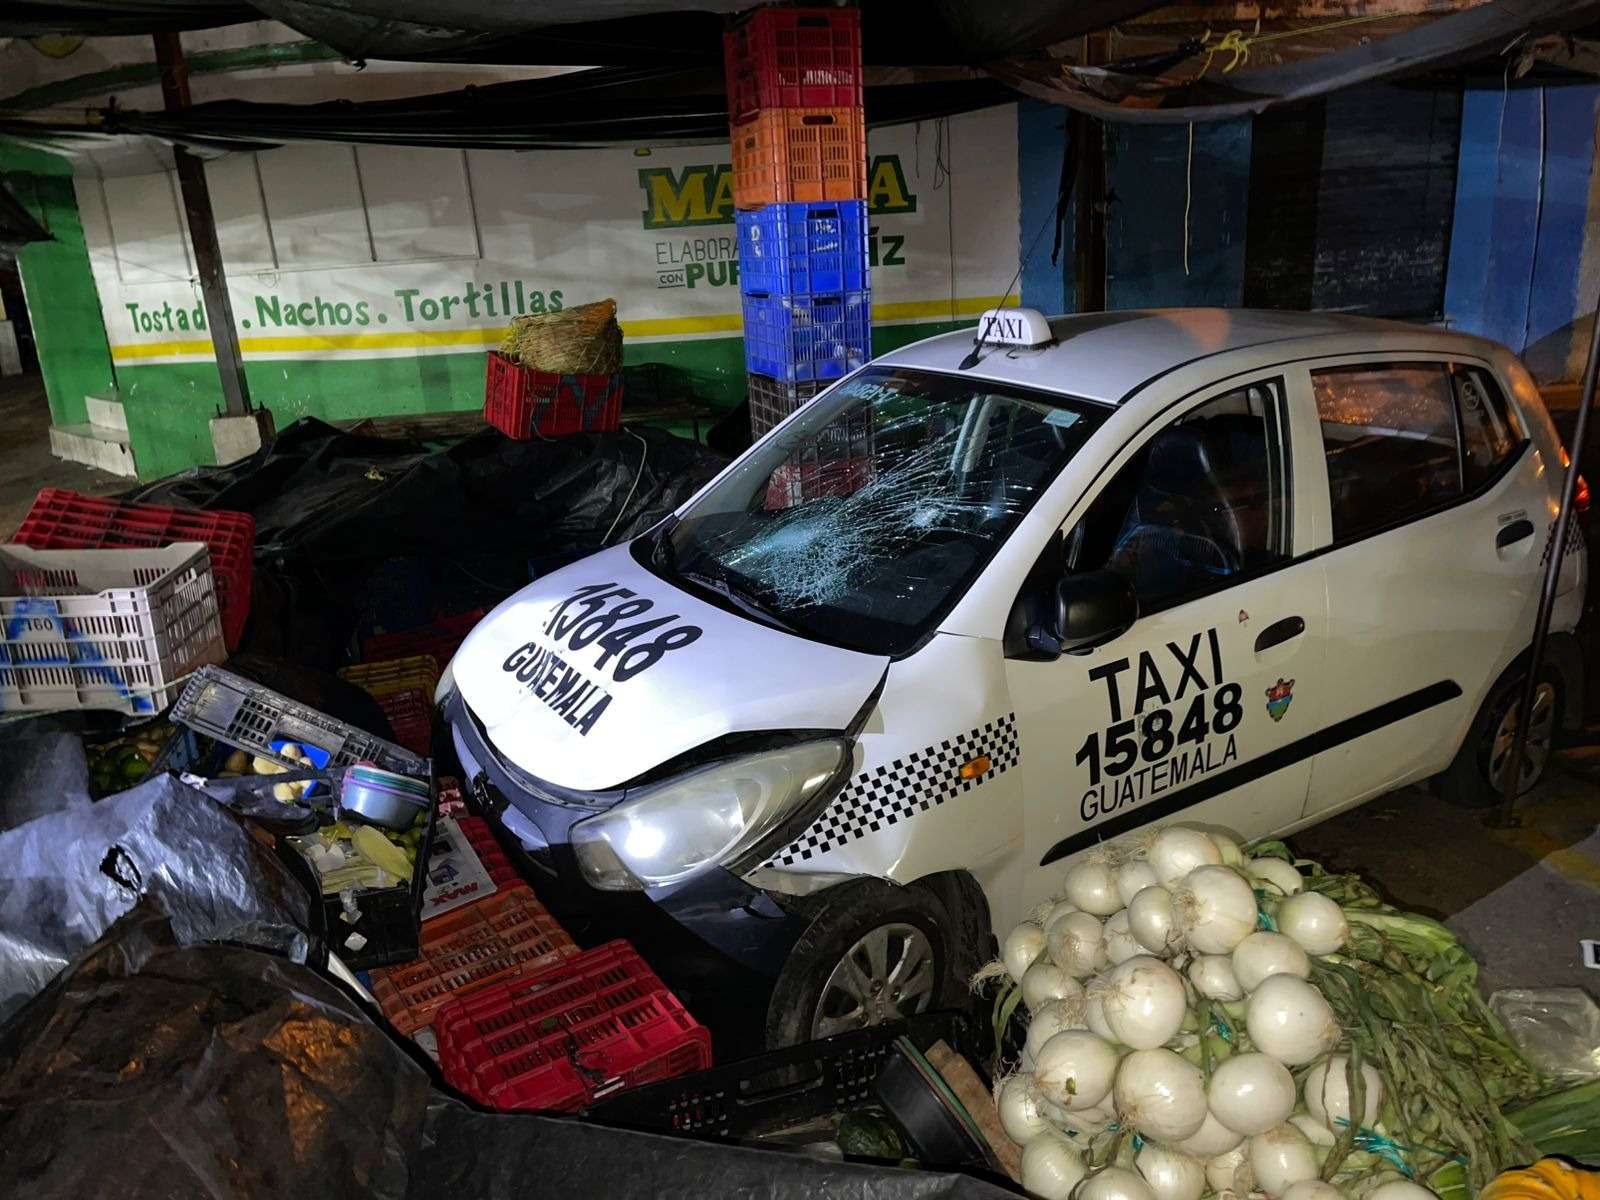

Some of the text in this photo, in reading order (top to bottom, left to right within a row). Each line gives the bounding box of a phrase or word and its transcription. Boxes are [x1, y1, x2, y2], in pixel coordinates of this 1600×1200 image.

[394, 280, 563, 321] Tortillas
[660, 273, 684, 284] CON
[984, 316, 1022, 339] TAXI
[542, 582, 703, 682] 15848
[1088, 628, 1223, 723] TAXI
[502, 641, 613, 737] GUATEMALA
[1075, 682, 1243, 787] 15848
[1080, 734, 1237, 821] GUATEMALA
